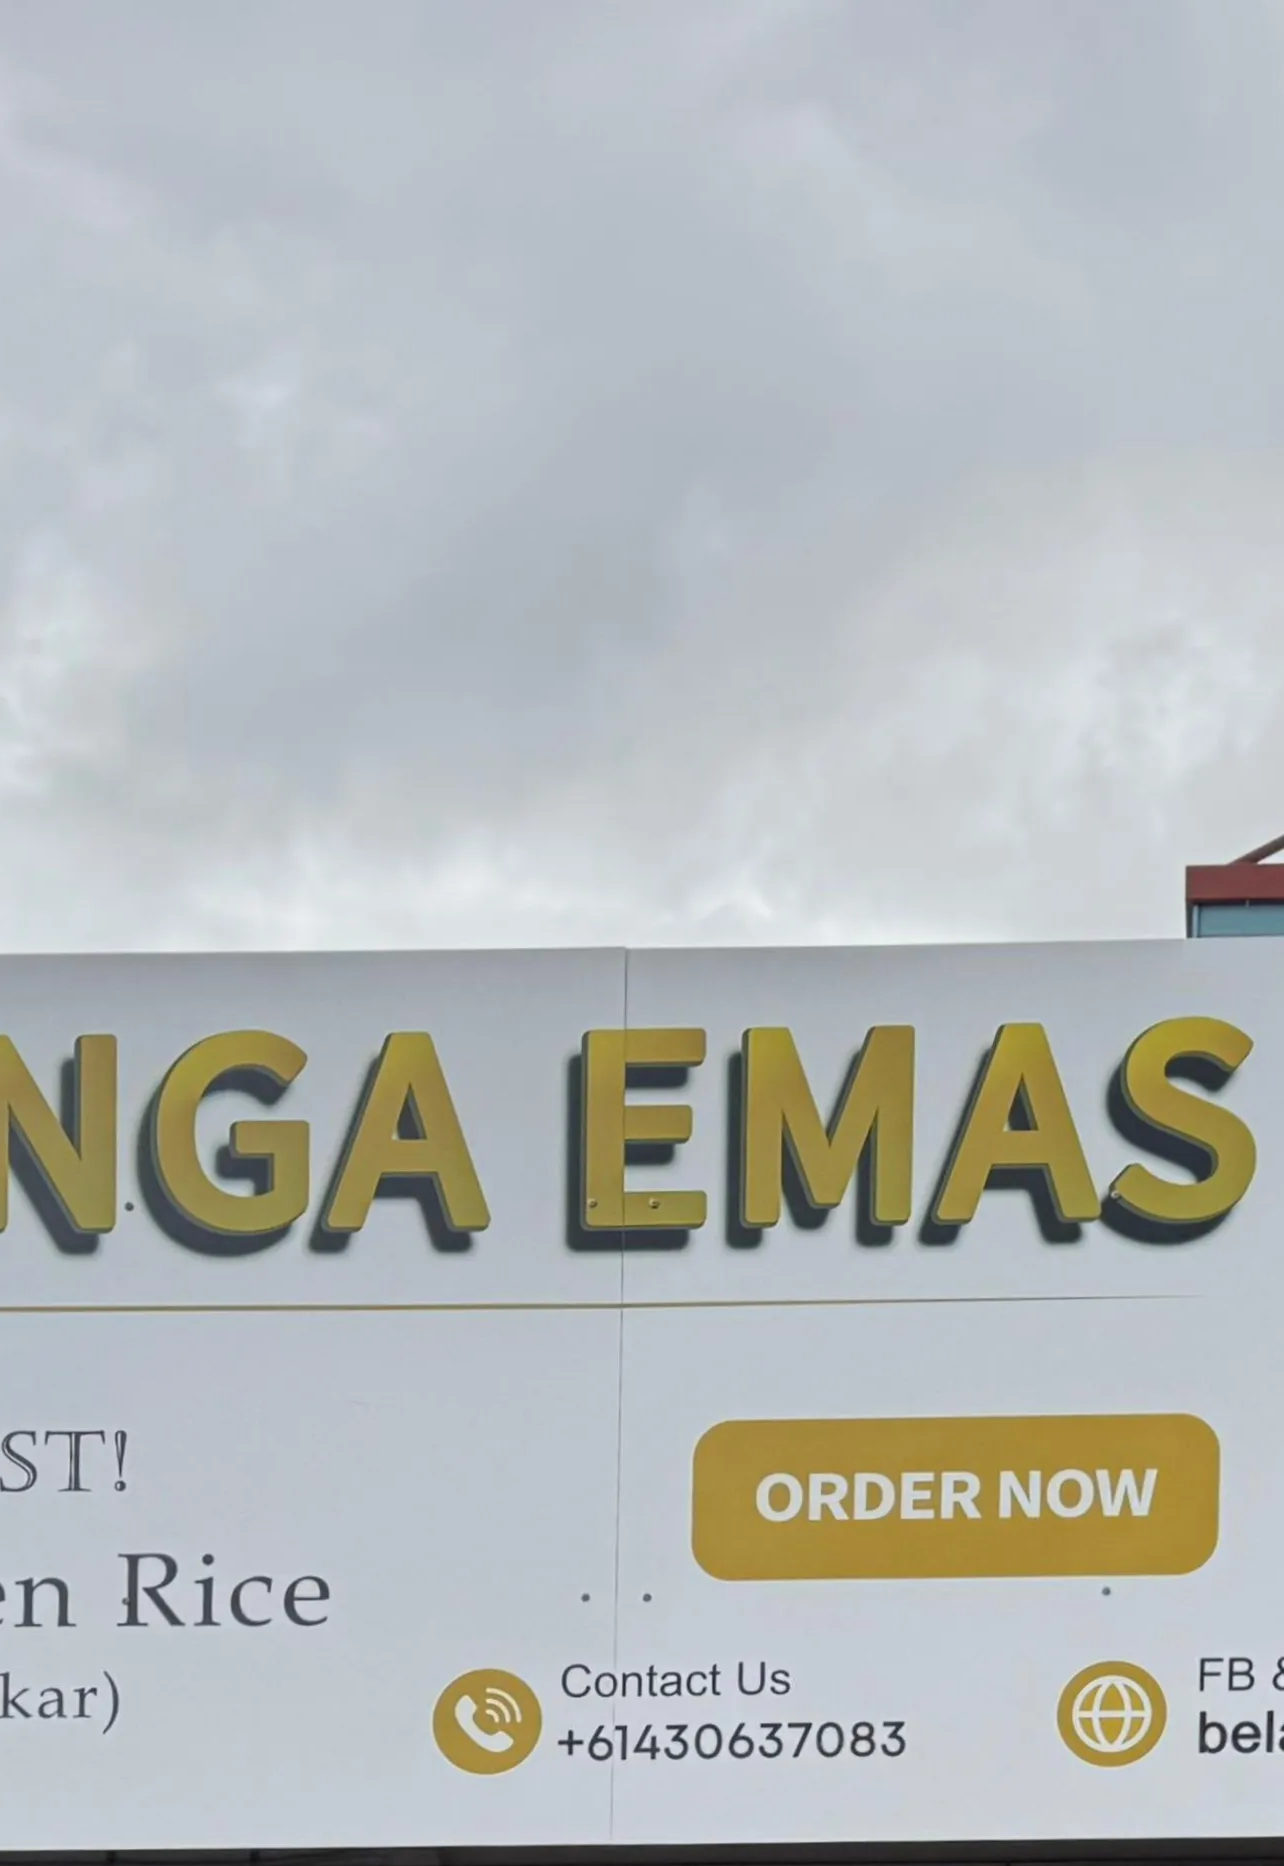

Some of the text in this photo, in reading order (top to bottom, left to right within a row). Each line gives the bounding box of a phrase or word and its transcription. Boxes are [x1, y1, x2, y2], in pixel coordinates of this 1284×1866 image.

[578, 1015, 1257, 1233] EMAS
[754, 1468, 1158, 1523] ORDER NOW
[117, 1551, 333, 1628] Rice
[559, 1661, 792, 1701] Contact Us
[1198, 1655, 1256, 1693] FB
[556, 1720, 908, 1761] +61430637083
